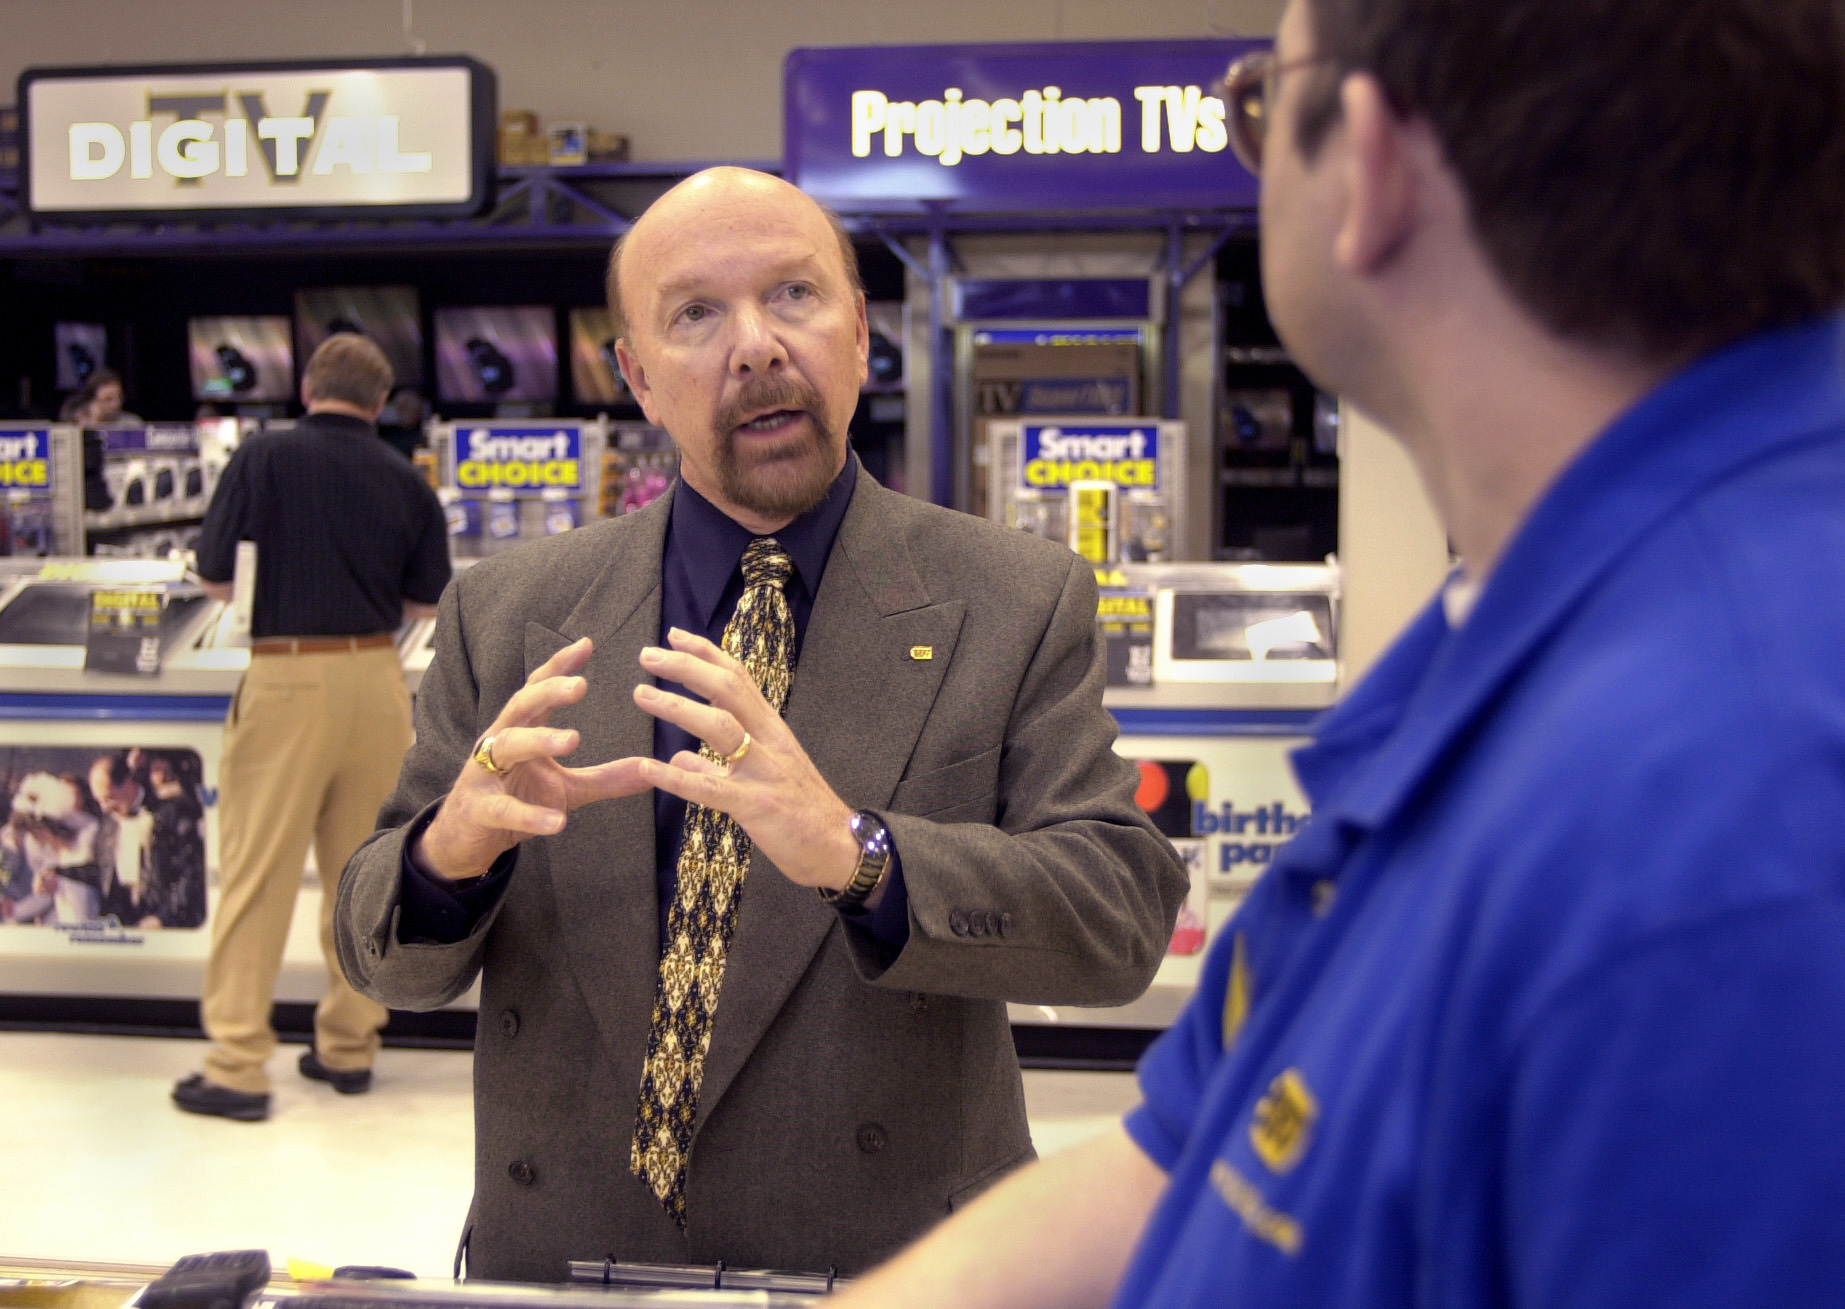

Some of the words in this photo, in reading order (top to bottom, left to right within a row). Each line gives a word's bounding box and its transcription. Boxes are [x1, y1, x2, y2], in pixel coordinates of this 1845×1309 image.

[145, 88, 332, 187] TV
[851, 85, 1122, 166] Projection
[1133, 85, 1229, 154] TVs
[68, 116, 433, 180] DIGITAL
[0, 431, 40, 460] art
[468, 428, 571, 461] Smart
[1038, 426, 1148, 461] Smart
[0, 459, 48, 486] ICE
[458, 460, 579, 487] CHOICE
[1025, 459, 1157, 487] CHOICE
